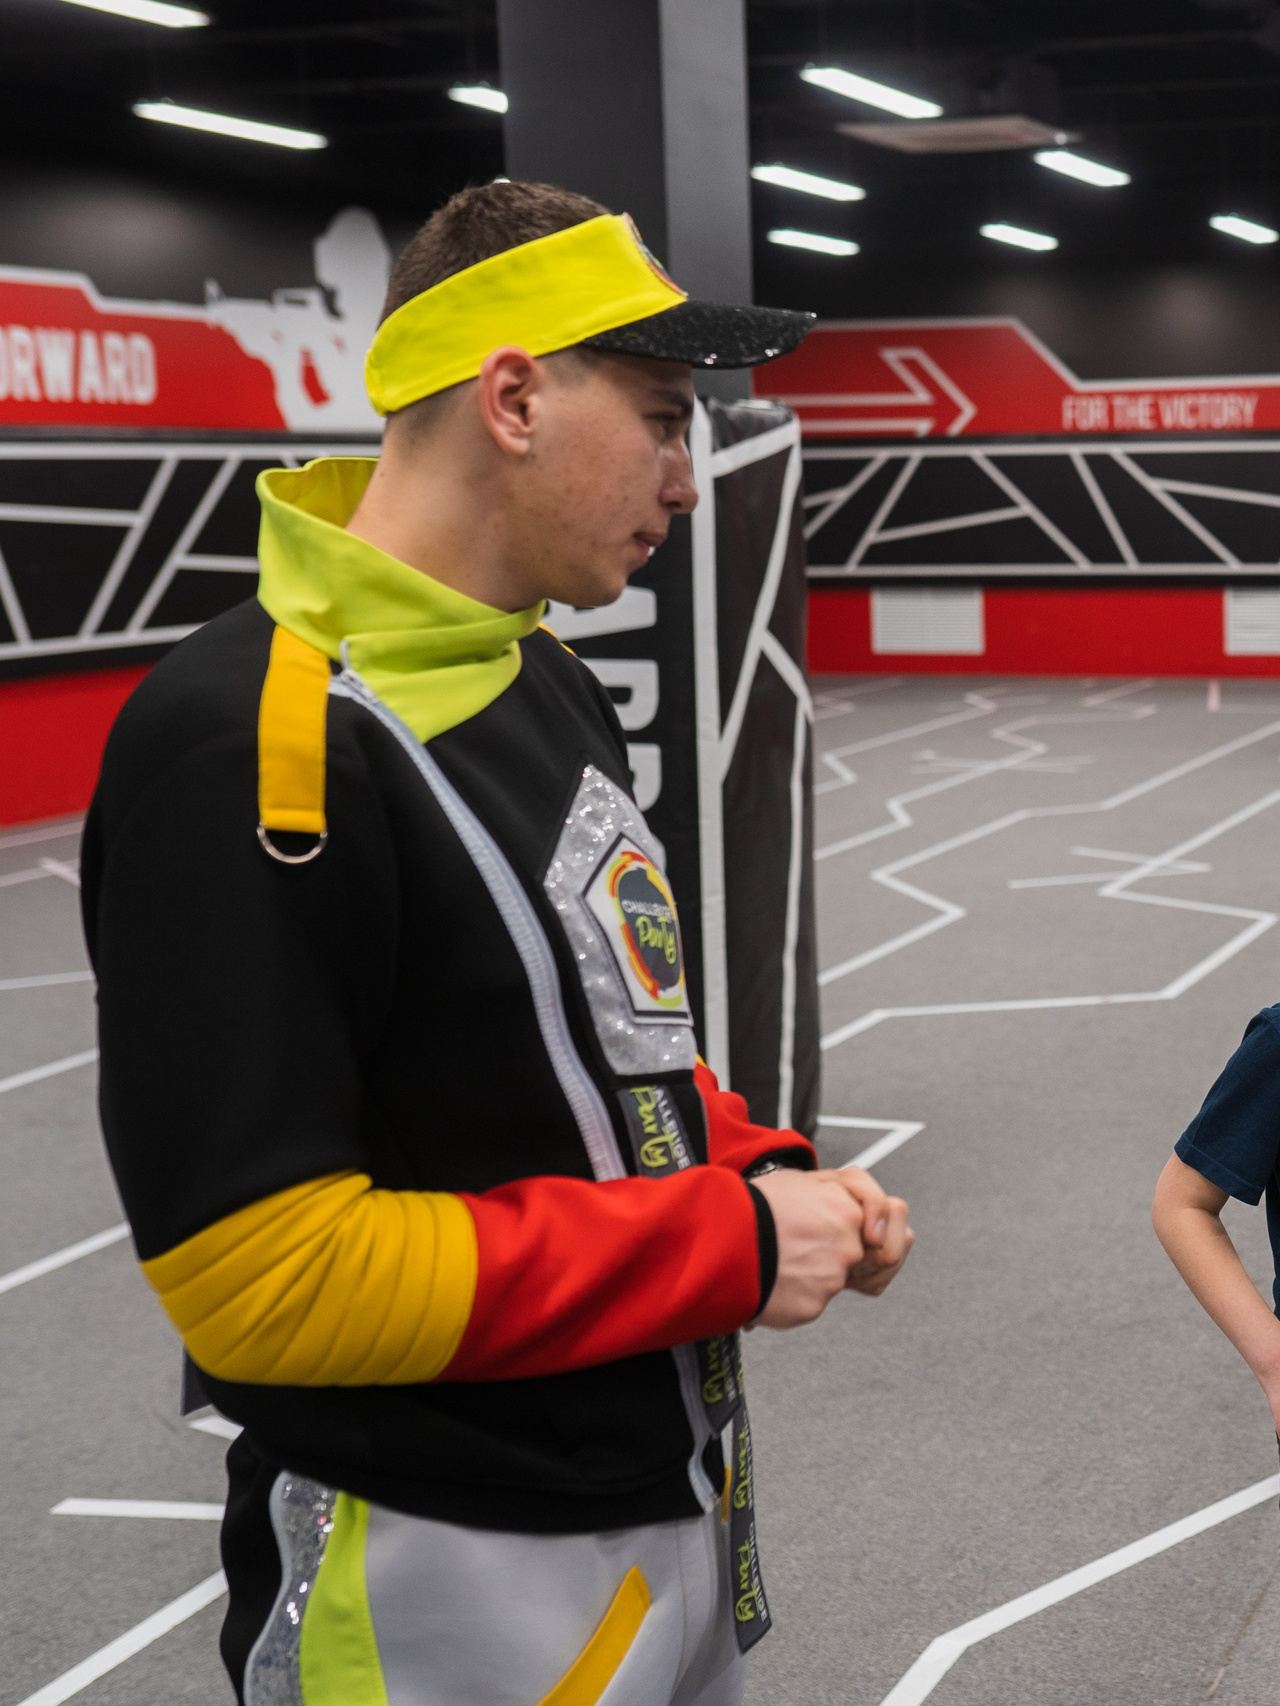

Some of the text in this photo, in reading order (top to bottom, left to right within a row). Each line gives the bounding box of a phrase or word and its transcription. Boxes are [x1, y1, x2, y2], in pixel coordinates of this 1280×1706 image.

[0, 324, 157, 405] RWARD
[1062, 392, 1258, 430] FOR THE VICTORY
[653, 1086, 691, 1170] ALLENGE
